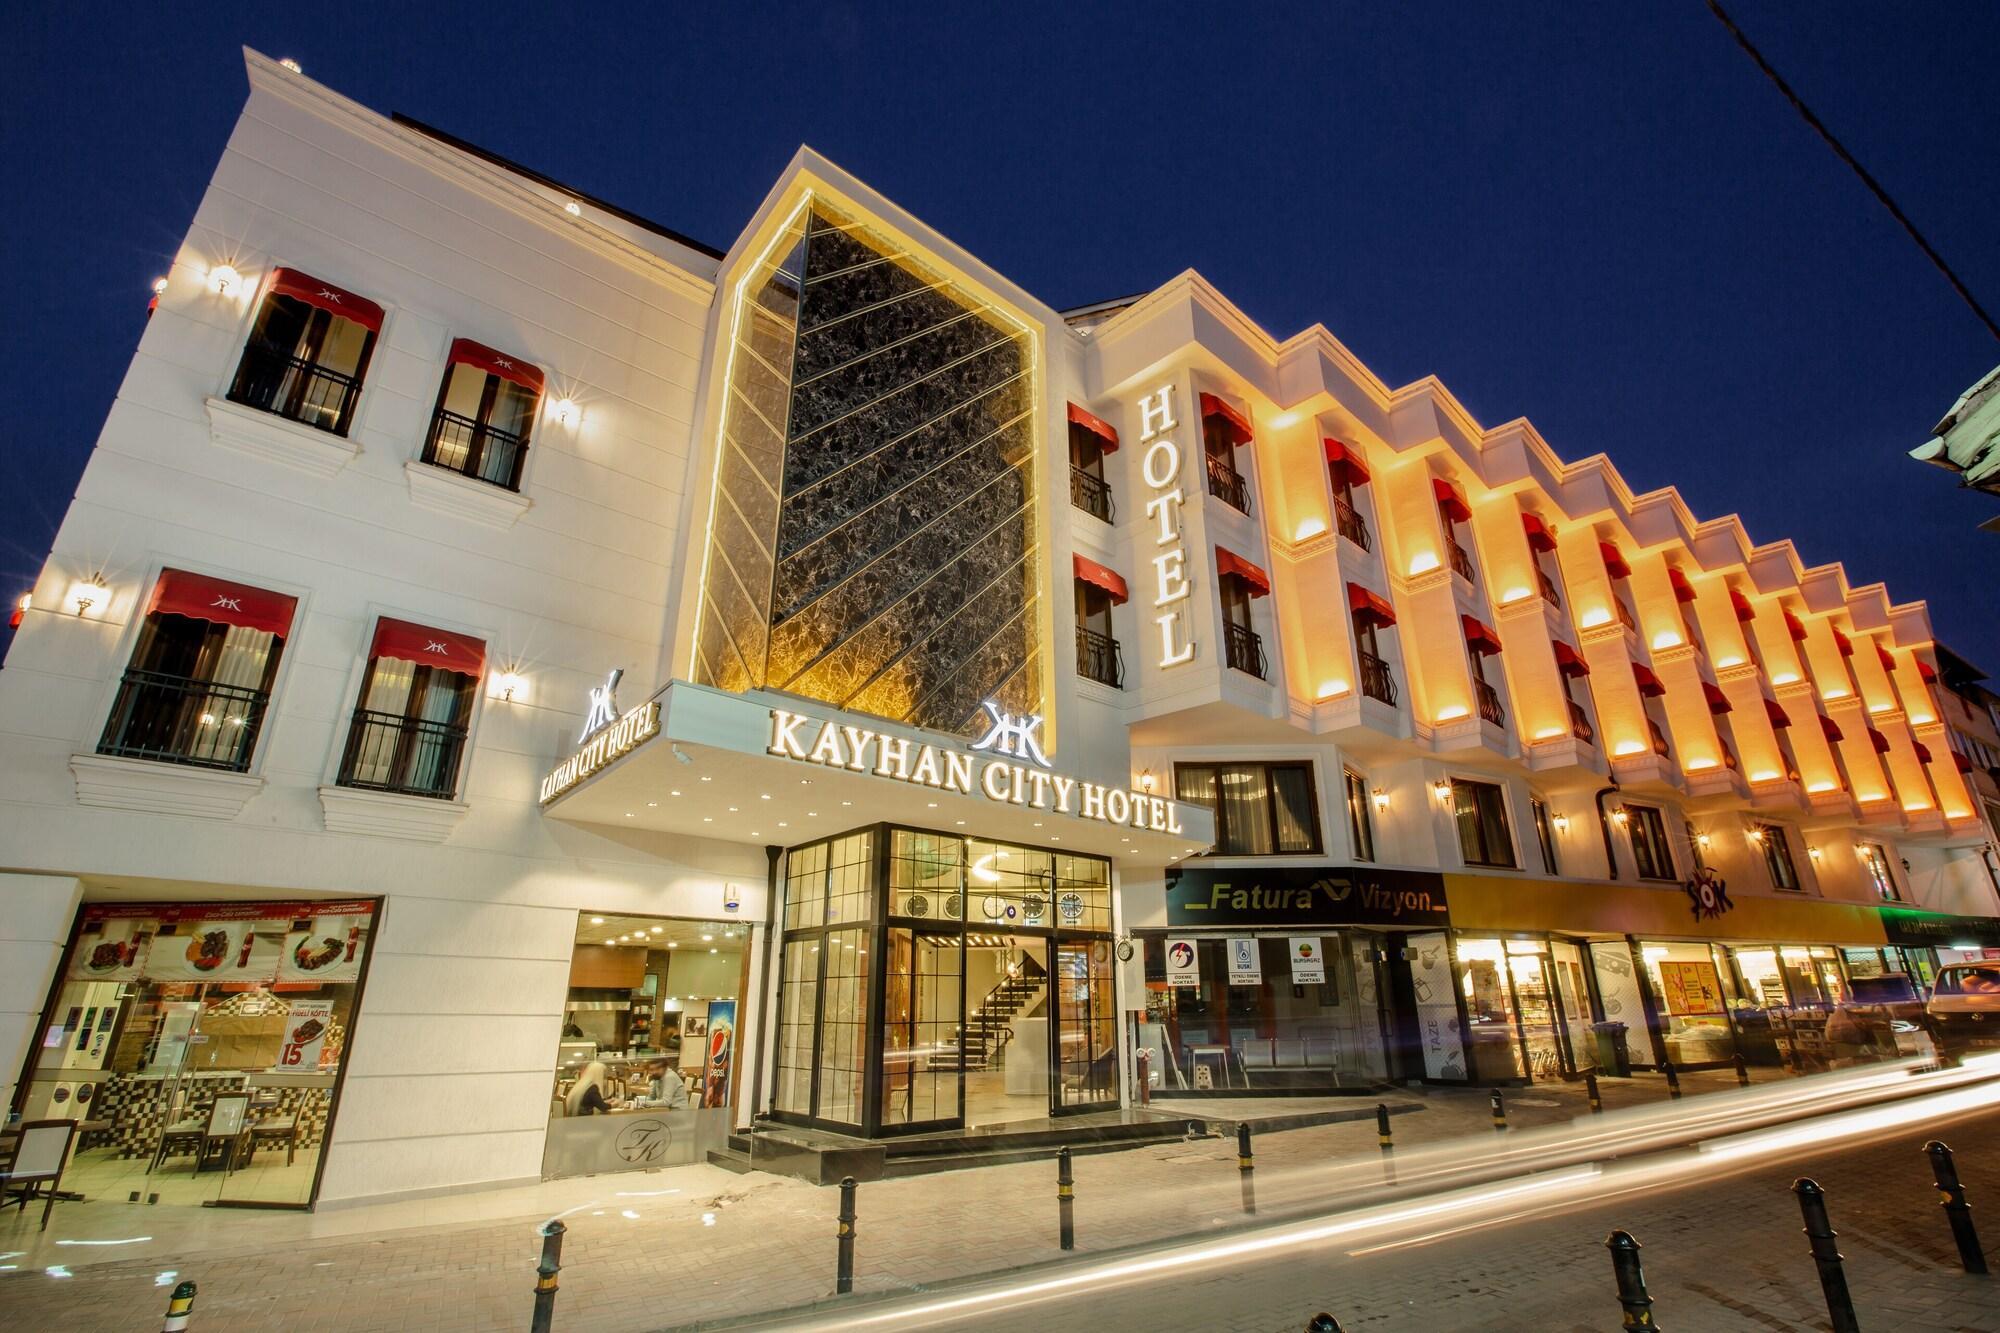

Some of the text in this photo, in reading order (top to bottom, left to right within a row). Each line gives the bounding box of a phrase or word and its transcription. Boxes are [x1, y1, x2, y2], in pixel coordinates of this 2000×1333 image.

[1138, 383, 1195, 669] HOTEL
[539, 701, 657, 803] KAYHAN CITY HOTEL
[767, 709, 1182, 834] KAYHAN CITY HOTEL
[1210, 883, 1431, 916] Fatura Vizyon
[1427, 1019, 1442, 1054] TAZE
[281, 1043, 304, 1066] 15
[710, 1067, 725, 1079] pepsi
